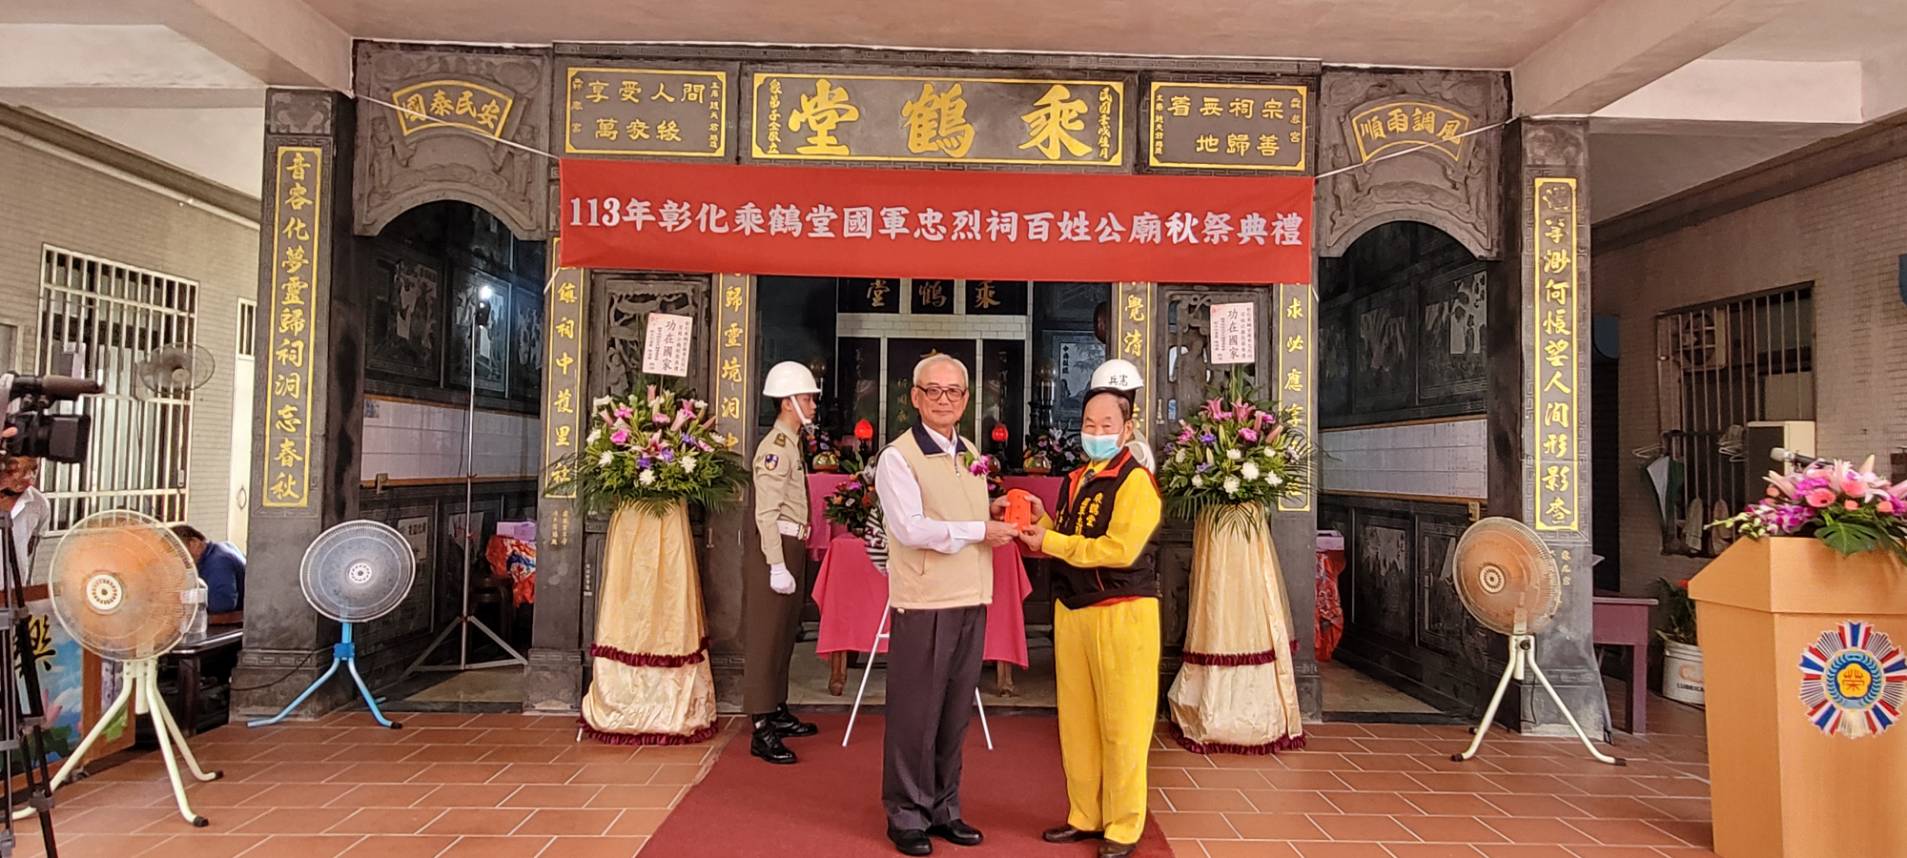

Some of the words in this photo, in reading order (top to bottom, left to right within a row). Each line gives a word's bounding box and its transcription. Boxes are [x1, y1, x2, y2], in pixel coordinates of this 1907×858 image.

[402, 89, 501, 129] 國泰民安
[788, 77, 1093, 161] 乘鶴堂
[1360, 107, 1461, 145] 風調雨順
[570, 196, 1304, 248] 113年彰化乘鶴堂國軍忠烈祠百姓公廟秋祭典禮
[662, 319, 677, 371] 功在國家
[1227, 307, 1240, 360] 功在國家
